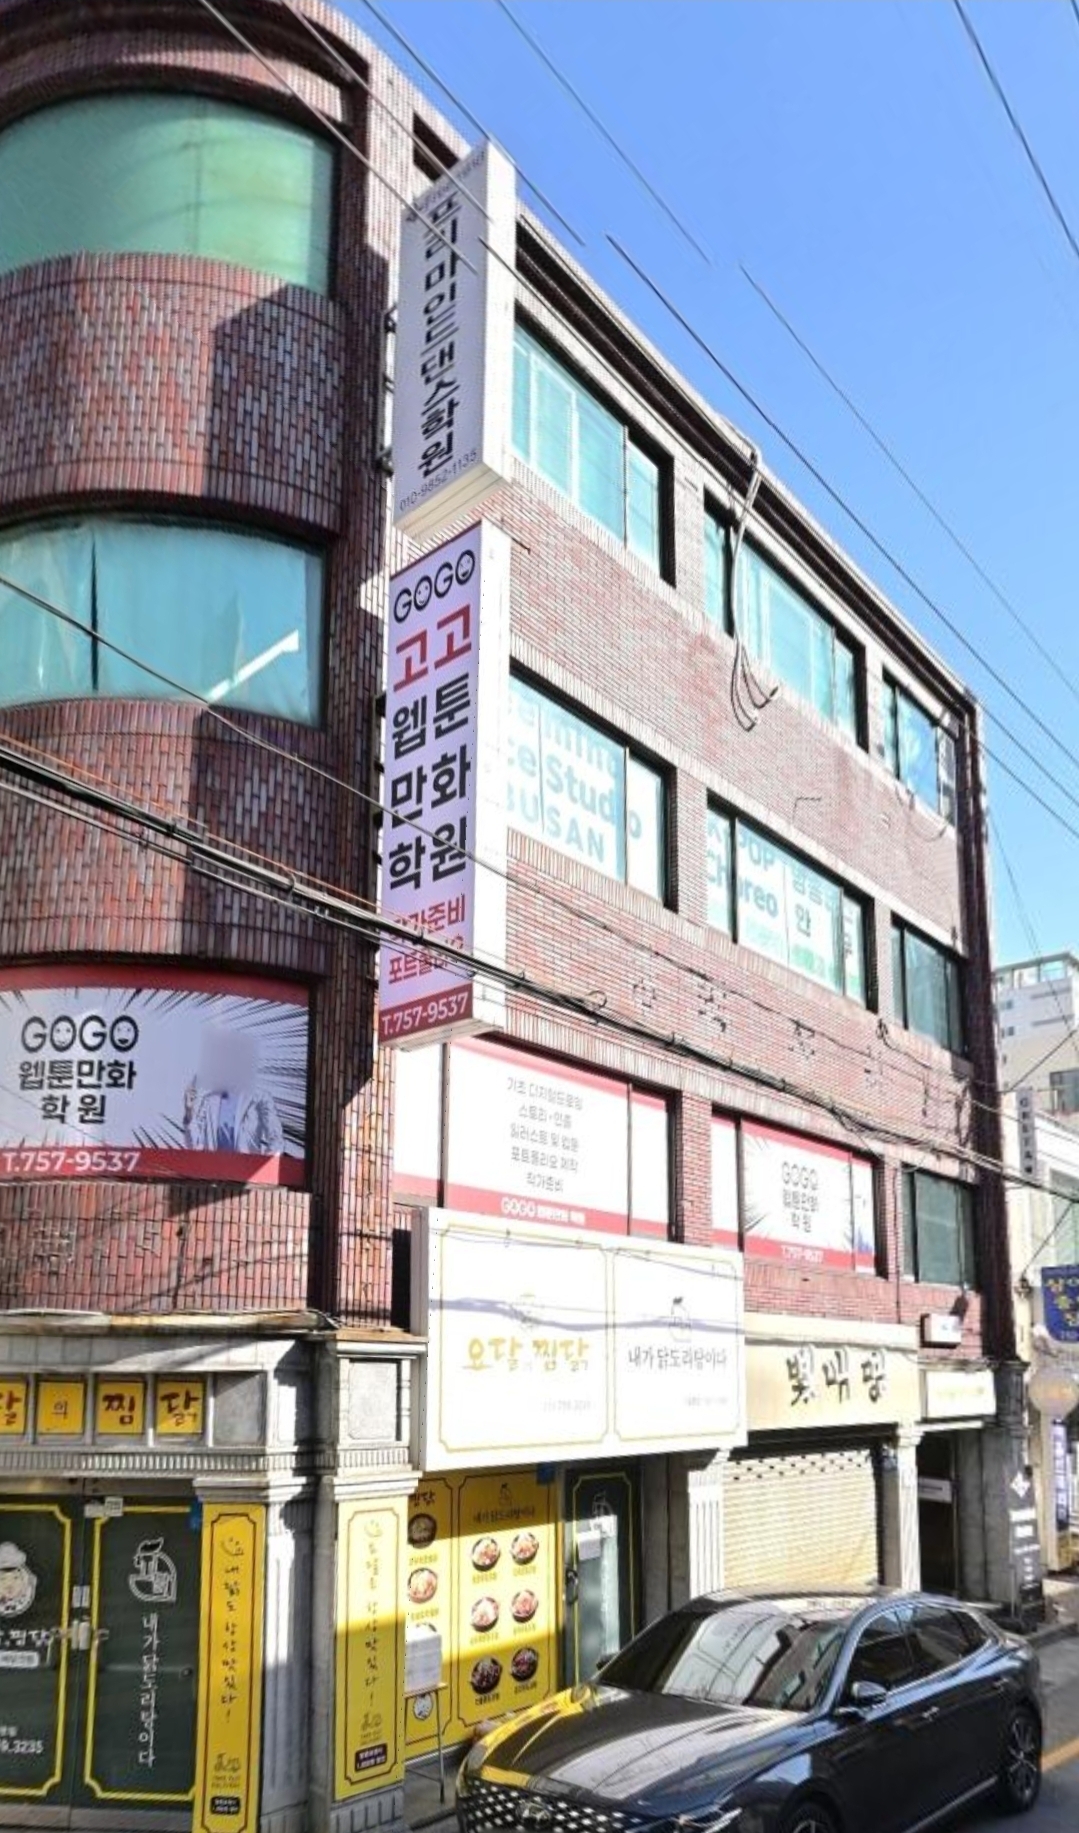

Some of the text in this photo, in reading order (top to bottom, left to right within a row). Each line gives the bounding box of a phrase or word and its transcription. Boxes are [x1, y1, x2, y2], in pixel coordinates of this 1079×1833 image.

[393, 549, 476, 623] GOGO
[393, 604, 472, 692] 고고
[393, 672, 471, 762] 웹툰
[390, 744, 471, 826] 만화
[389, 816, 468, 891] 학원
[21, 1014, 139, 1053] GOGO
[381, 992, 469, 1035] T.757-9537
[18, 1059, 137, 1091] 웹툰만화
[3, 1151, 140, 1173] T.757-9537
